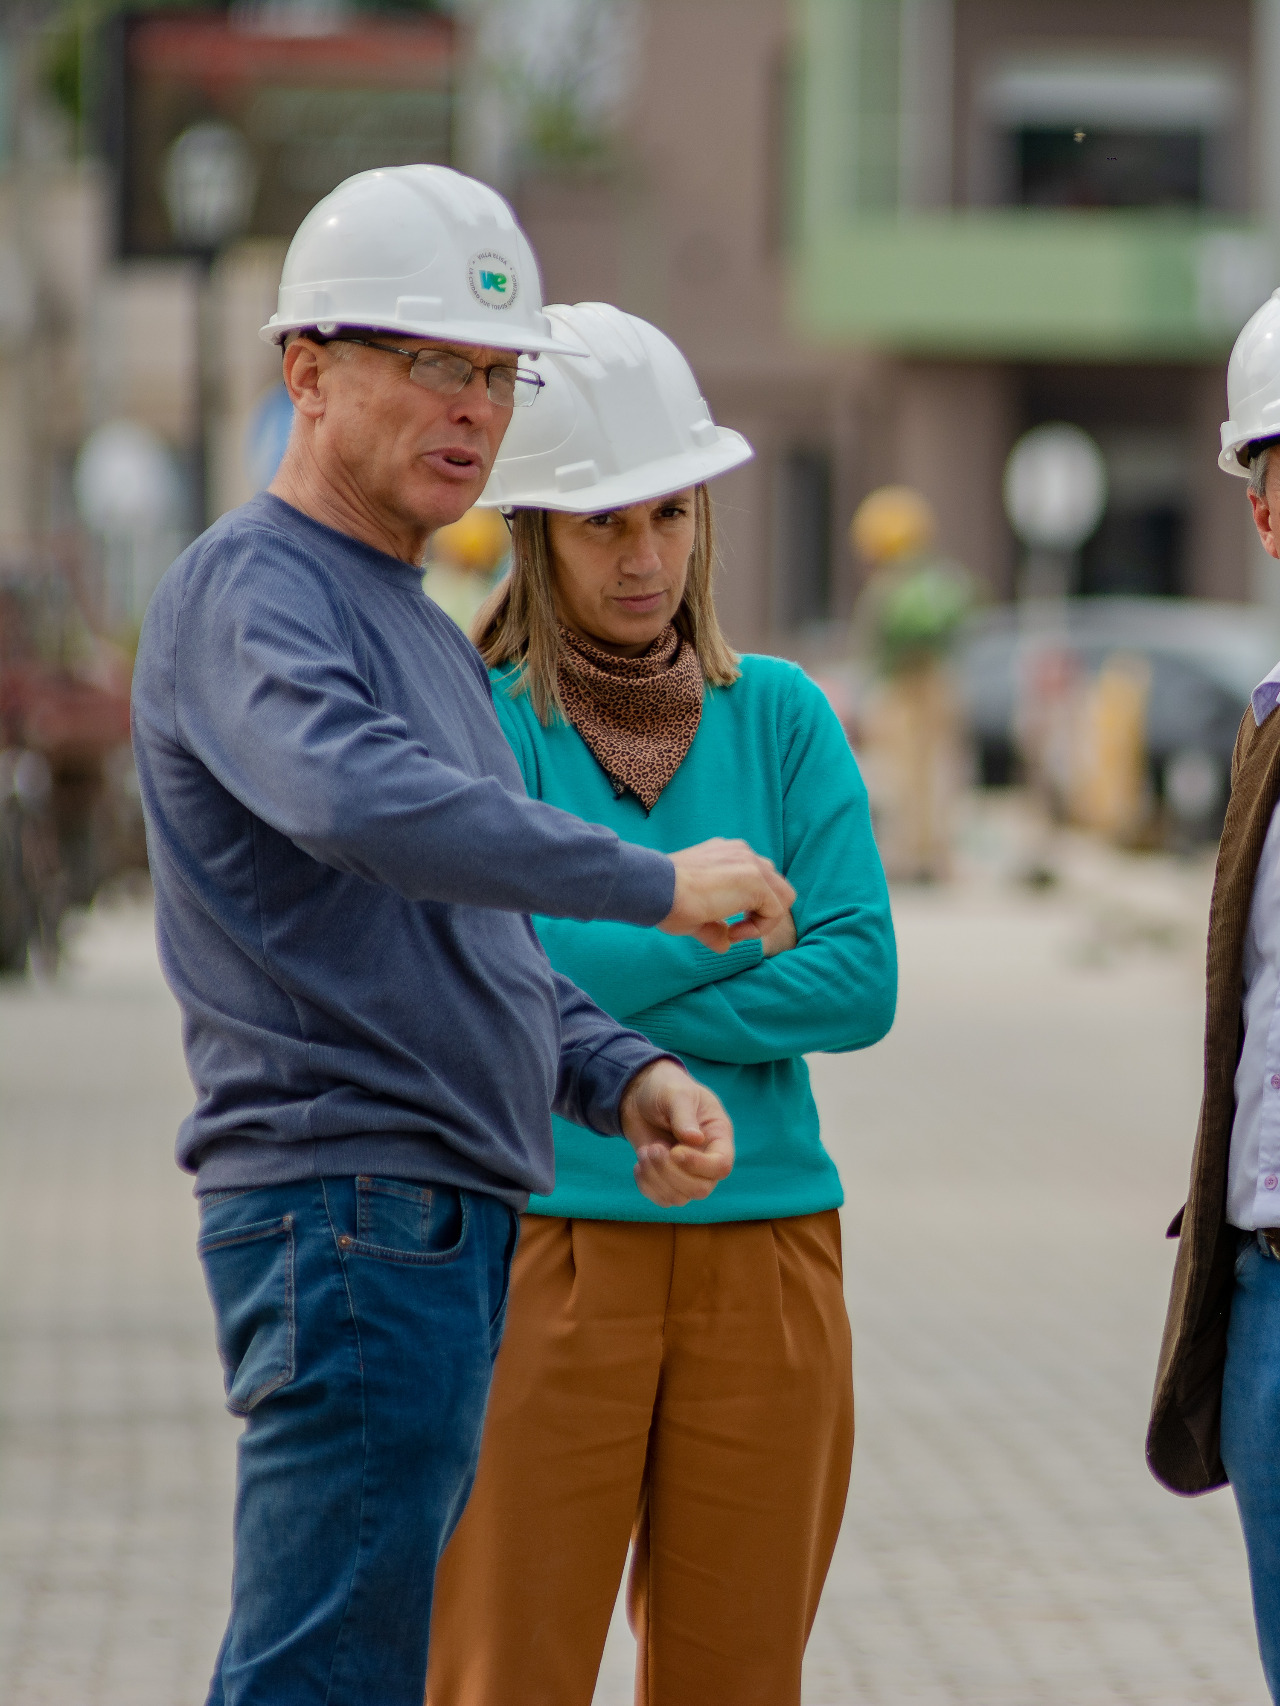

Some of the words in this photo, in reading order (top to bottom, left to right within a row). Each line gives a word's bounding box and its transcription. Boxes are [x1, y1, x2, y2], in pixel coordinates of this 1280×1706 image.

[477, 252, 492, 260] VILLA
[492, 253, 507, 266] ELISA
[468, 267, 474, 275] LA
[468, 276, 480, 299] CIUDAD
